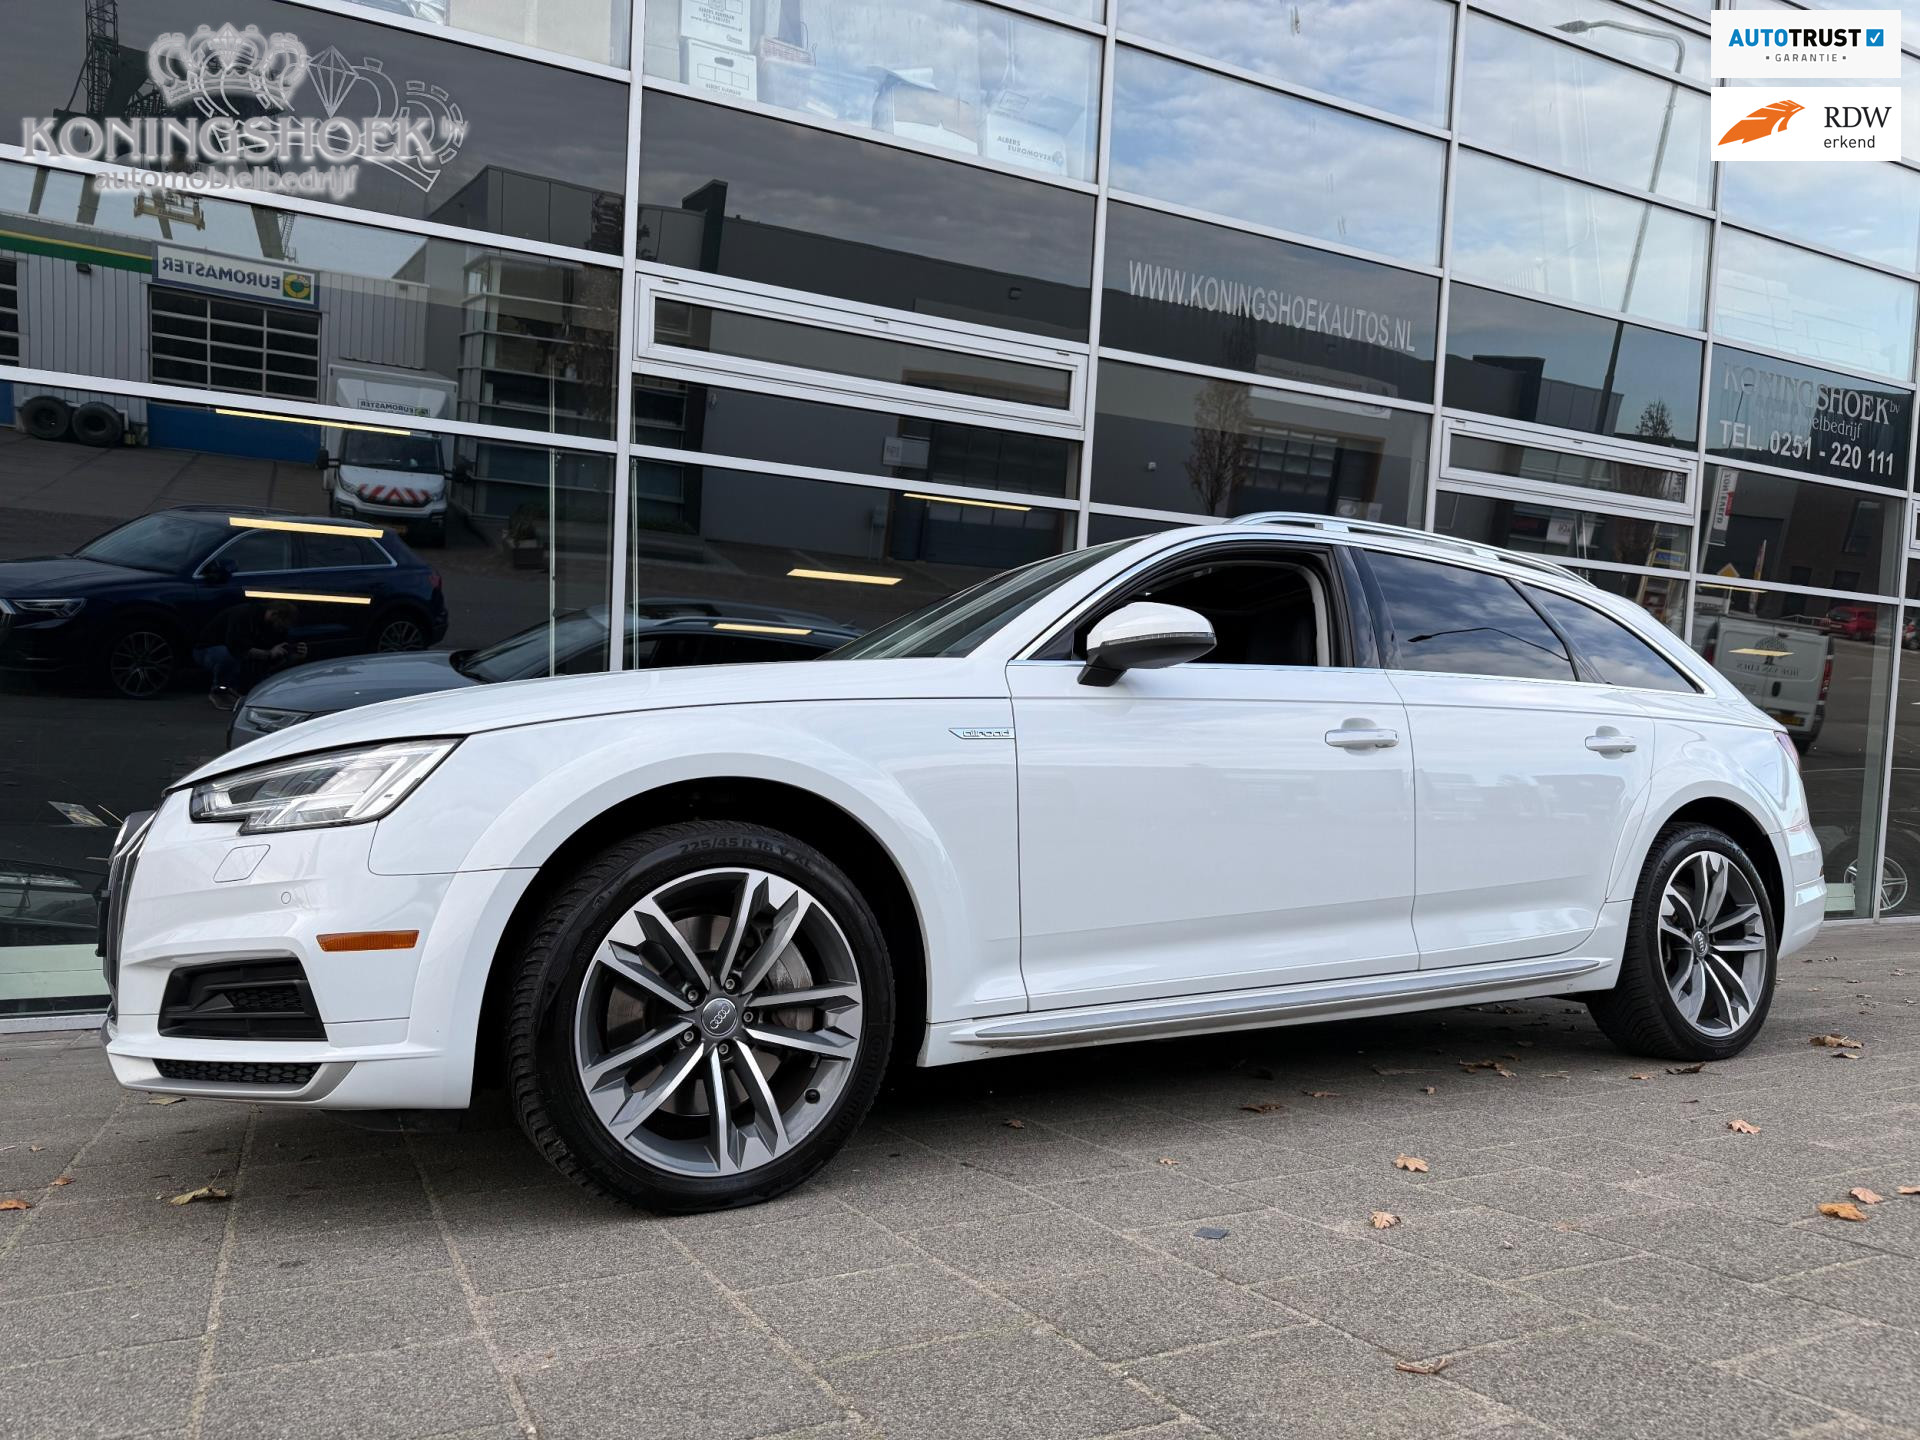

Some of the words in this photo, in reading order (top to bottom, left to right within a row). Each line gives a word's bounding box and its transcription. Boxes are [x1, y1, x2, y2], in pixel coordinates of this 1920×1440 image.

[1129, 259, 1416, 352] WWW.KONINGSHOEKAUTOS.NL
[1722, 362, 1891, 425] KONINGSHOEK
[1719, 419, 1763, 451] TEL.
[1770, 430, 1812, 460] 0251
[1829, 441, 1862, 470] 220
[1868, 449, 1894, 476] 111
[678, 837, 739, 855] 225/45
